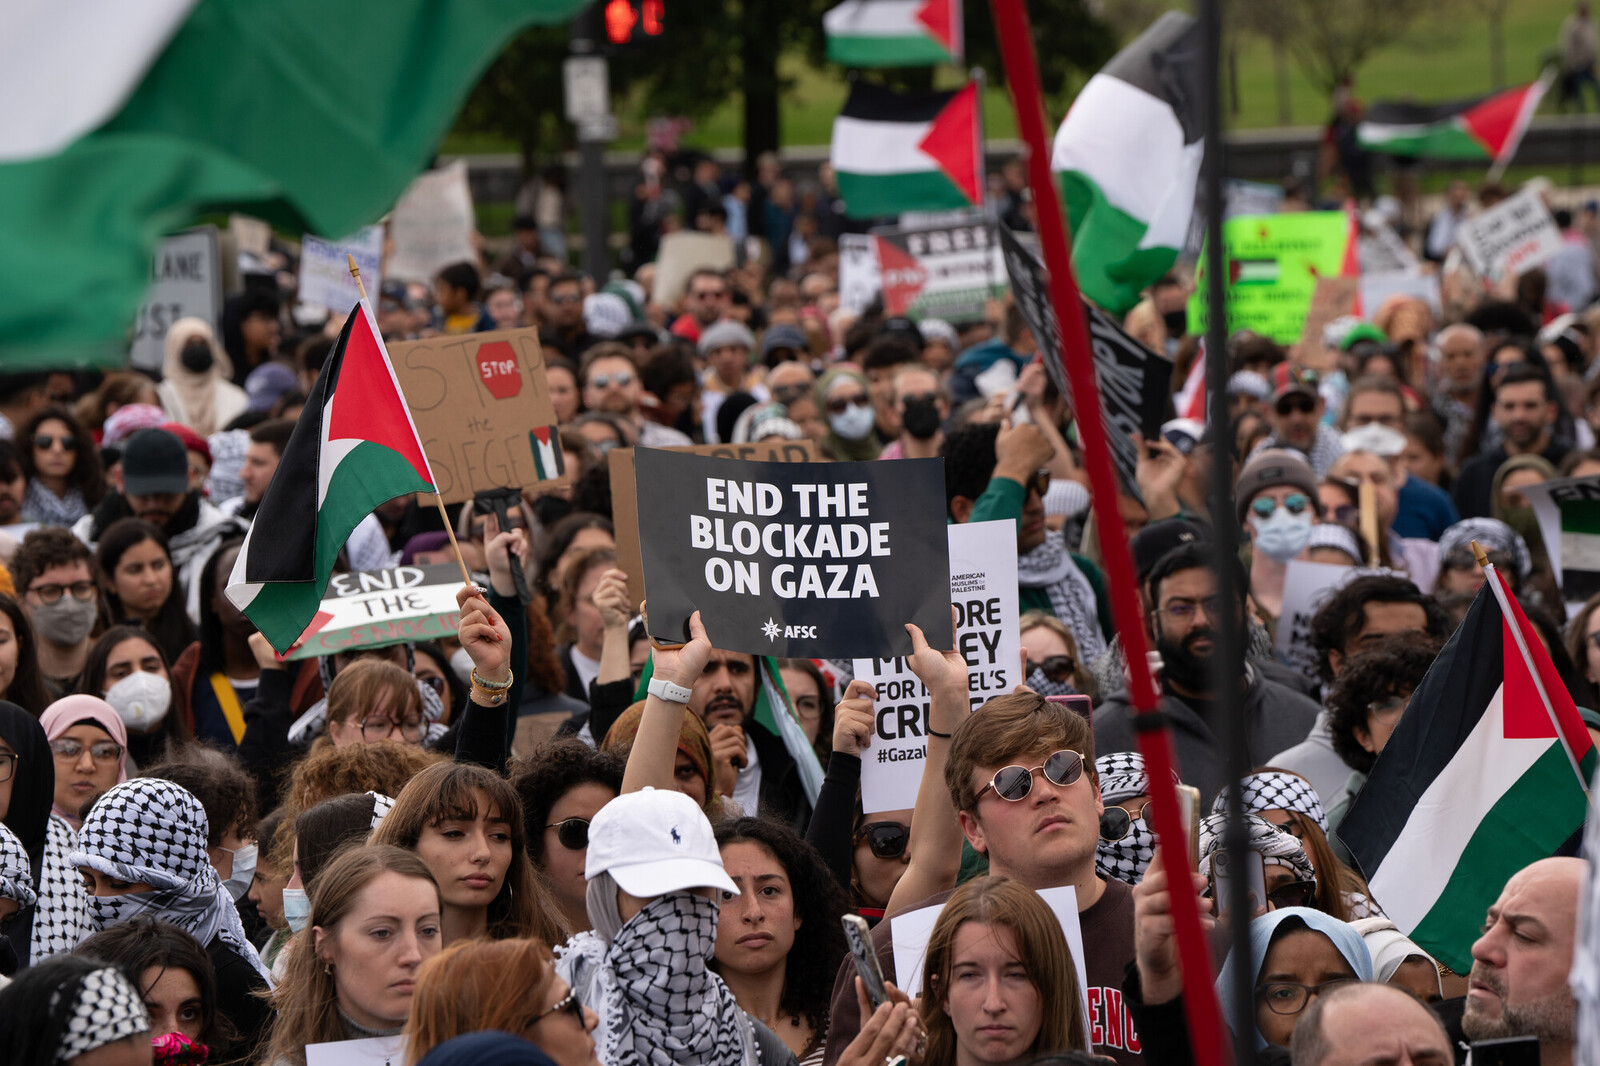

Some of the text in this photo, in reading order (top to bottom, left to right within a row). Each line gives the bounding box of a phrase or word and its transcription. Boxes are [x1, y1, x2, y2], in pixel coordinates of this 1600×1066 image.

[481, 360, 516, 379] STOP
[467, 416, 494, 434] the
[707, 478, 869, 518] END THE
[690, 515, 891, 558] BLOCKADE
[331, 567, 425, 597] END
[705, 557, 880, 599] ON GAZA
[951, 572, 986, 581] AMERICAN
[951, 580, 979, 588] MUSLIMS
[951, 585, 986, 593] PALESTINE
[352, 593, 431, 617] THE
[951, 598, 1002, 629] ORE
[319, 612, 460, 649] GENOCID
[784, 625, 817, 639] AFSC
[875, 679, 916, 702] FOR
